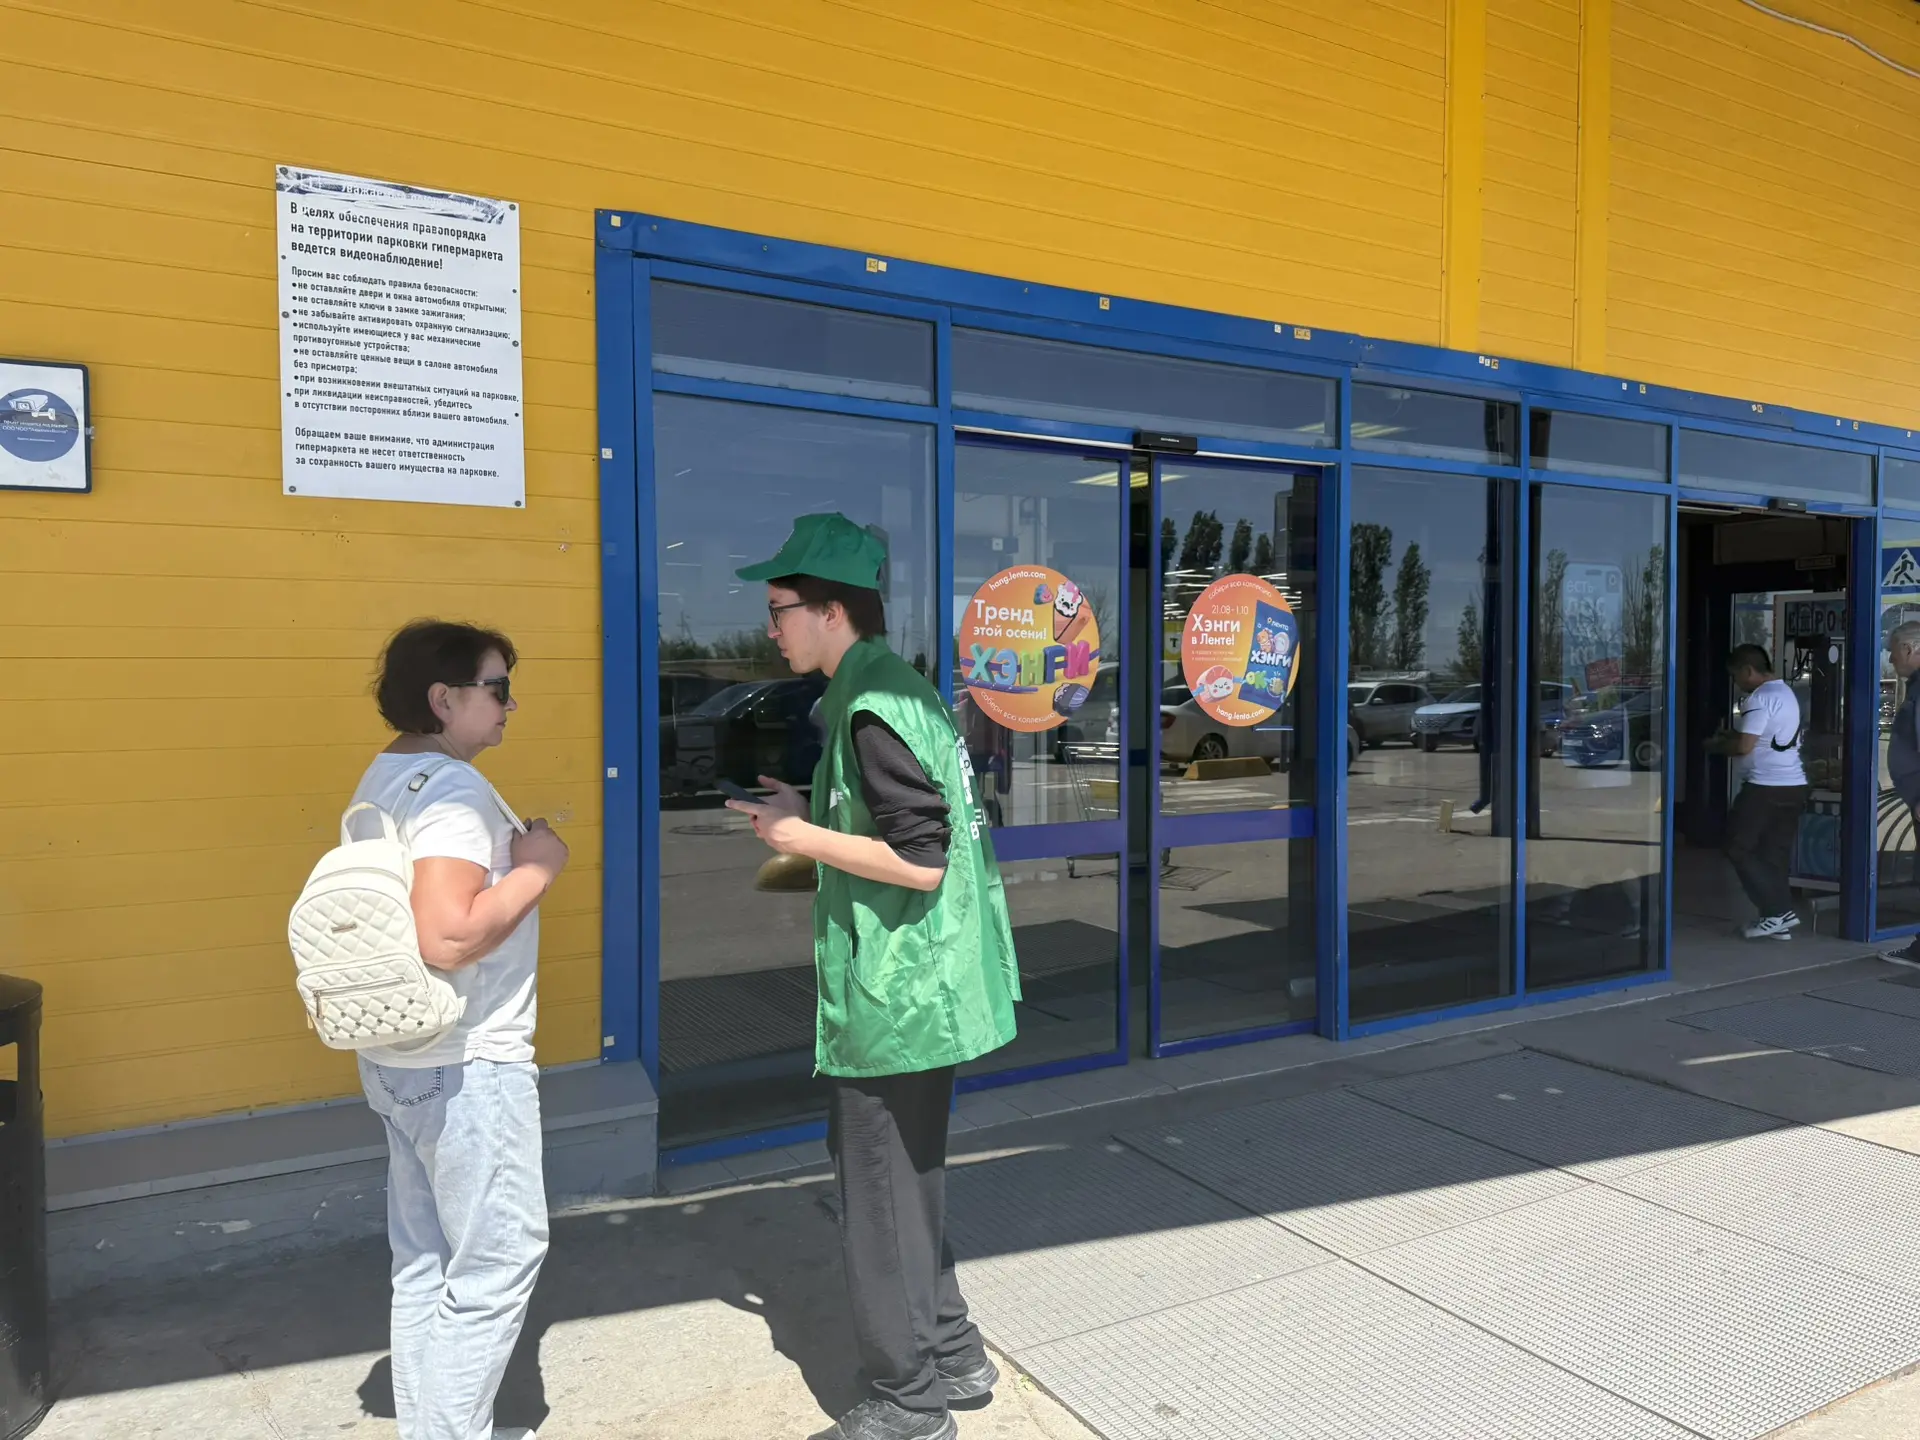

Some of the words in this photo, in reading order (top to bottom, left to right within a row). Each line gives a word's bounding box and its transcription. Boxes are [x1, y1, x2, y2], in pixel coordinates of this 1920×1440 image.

[290, 201, 297, 213] В
[338, 210, 408, 230] обеспечения
[412, 222, 486, 241] правопорядка
[290, 222, 304, 233] на
[307, 225, 373, 243] территории
[376, 235, 427, 250] парковки
[431, 242, 503, 261] гипермаркета
[291, 241, 335, 256] ведется
[339, 248, 442, 269] видеонаблюдение!
[291, 265, 323, 278] Просим
[325, 272, 340, 280] вас
[342, 273, 386, 285] соблюдать
[388, 279, 421, 289] правила
[297, 295, 308, 303] не
[310, 296, 356, 308] оставляйте
[358, 302, 385, 311] ключи
[394, 305, 418, 314] замке
[310, 283, 356, 295] оставляйте
[358, 289, 383, 299] двери
[393, 293, 412, 301] окна
[414, 295, 460, 307] автомобиля
[298, 308, 308, 316] не
[310, 309, 355, 321] забывайте
[357, 315, 412, 327] активировать
[414, 320, 452, 332] охранную
[293, 334, 361, 347] противоугонные
[298, 321, 350, 334] используйте
[352, 327, 401, 338] имеющиеся
[403, 332, 408, 341] у
[410, 333, 424, 341] вас
[426, 335, 480, 347] механические
[293, 358, 308, 368] без
[311, 349, 358, 360] оставляйте
[360, 354, 391, 363] ценные
[393, 357, 414, 366] вещи
[424, 360, 451, 369] салоне
[453, 363, 497, 374] автомобиля
[294, 387, 309, 397] при
[311, 389, 362, 399] ликвидации
[364, 393, 431, 406] неисправностей,
[433, 398, 472, 409] убедитесь
[299, 374, 315, 384] при
[317, 376, 380, 388] возникновении
[383, 381, 430, 392] внештатных
[432, 386, 468, 396] ситуаций
[482, 391, 518, 402] парковке,
[302, 401, 347, 411] отсутствии
[349, 405, 400, 415] посторонних
[402, 407, 430, 418] вблизи
[432, 412, 460, 420] вашего
[462, 415, 509, 425] автомобиля.
[294, 426, 341, 439] Обращаем
[343, 432, 366, 440] ваше
[368, 434, 413, 444] внимание,
[415, 437, 429, 445] что
[432, 439, 494, 450] администрация
[295, 442, 356, 454] гипермаркета
[371, 448, 395, 456] несет
[398, 449, 465, 461] ответственность
[295, 456, 305, 464] за
[308, 457, 362, 468] сохранность
[365, 461, 396, 470] вашего
[398, 463, 444, 473] имущества
[459, 467, 499, 477] парковке.
[988, 571, 1047, 591] hang.lenta.com
[1208, 583, 1229, 600] собери
[974, 599, 1034, 626] Тренд
[1191, 613, 1240, 633] Хэнги
[973, 624, 1002, 637] этой
[1005, 628, 1047, 639] осени!
[1191, 636, 1198, 645] в
[1199, 633, 1235, 646] Ленте!
[967, 640, 1090, 687] ХЭНГИ
[1250, 650, 1293, 668] ХЭНГИ
[980, 691, 1003, 716] собери
[1003, 711, 1017, 721] всю
[1018, 711, 1057, 724] коллекцию
